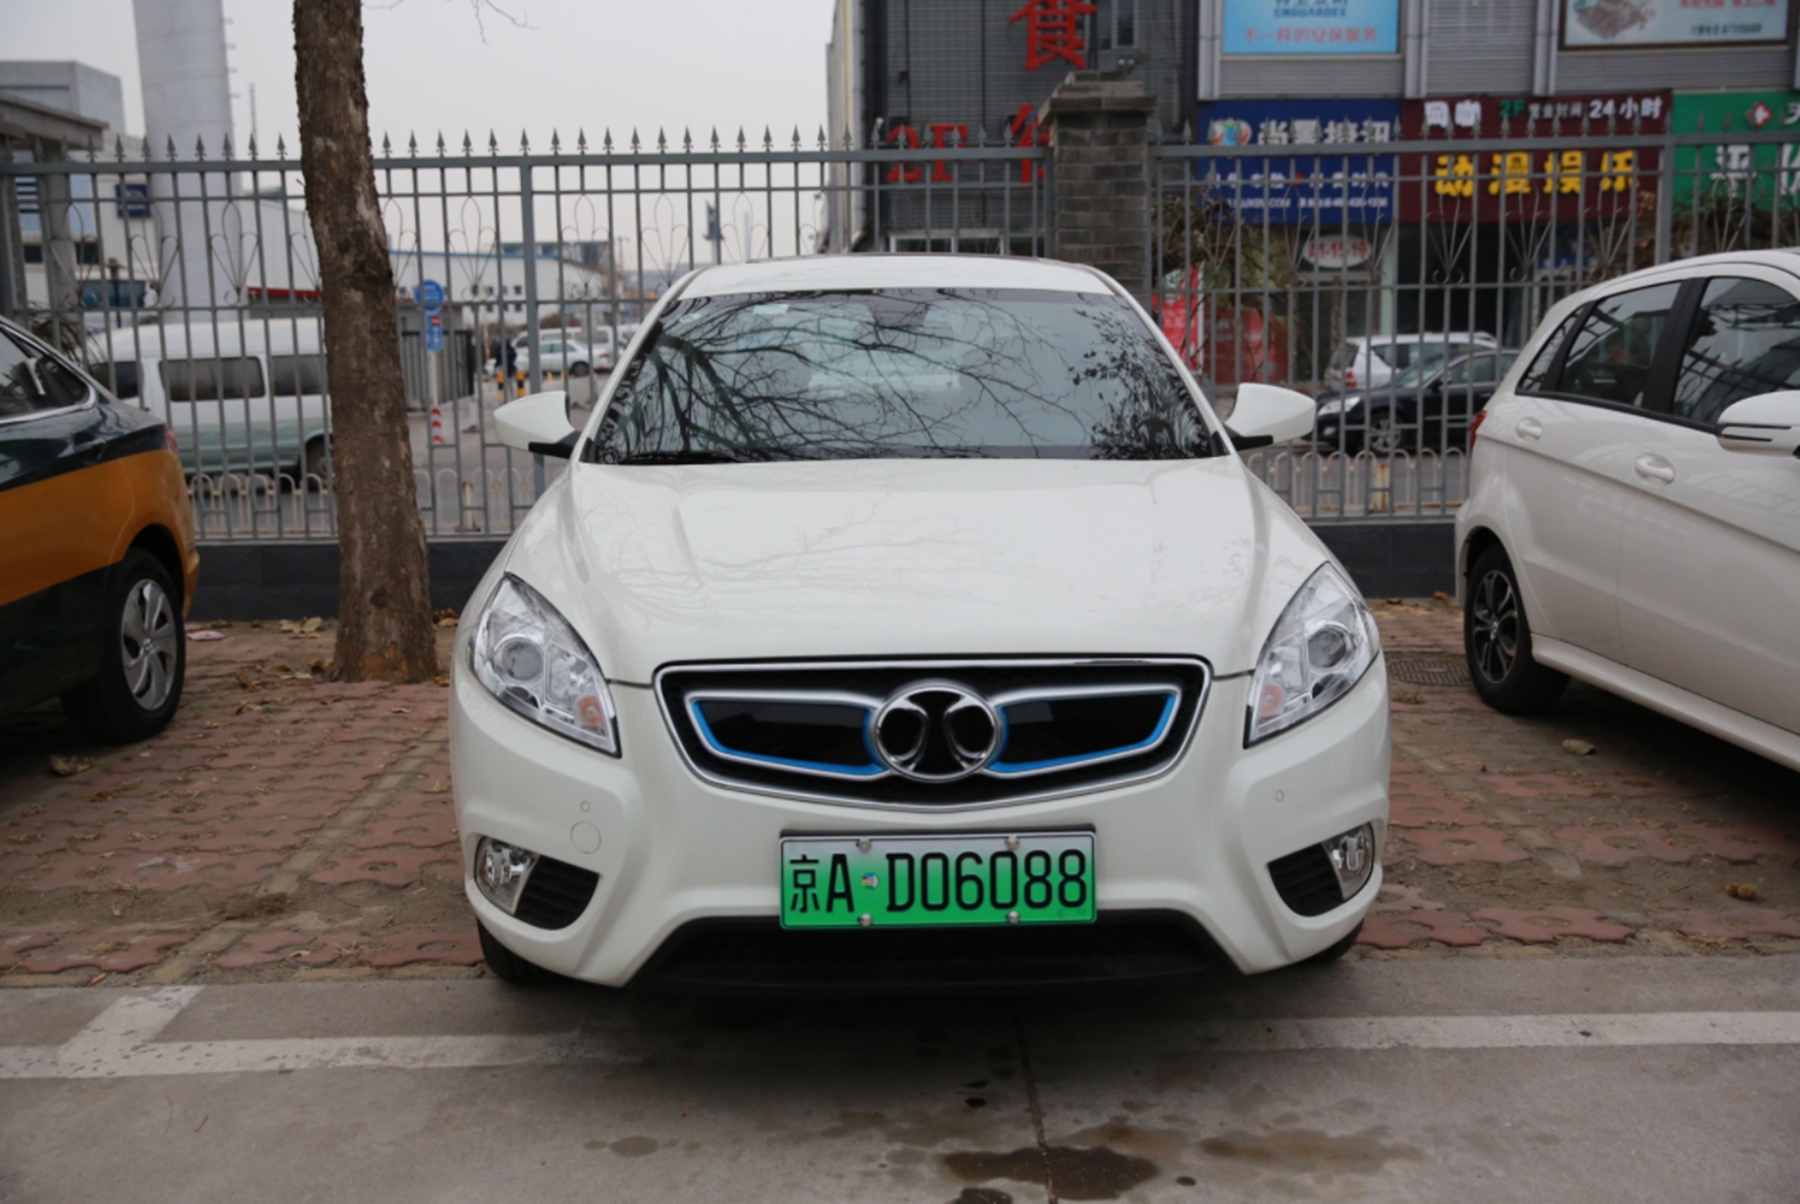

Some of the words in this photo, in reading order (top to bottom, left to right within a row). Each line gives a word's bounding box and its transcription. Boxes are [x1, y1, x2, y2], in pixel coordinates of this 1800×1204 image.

[1009, 0, 1097, 72] 食
[1244, 26, 1377, 43] 不一样的安保服务
[1434, 150, 1640, 197] 动漫娱乐
